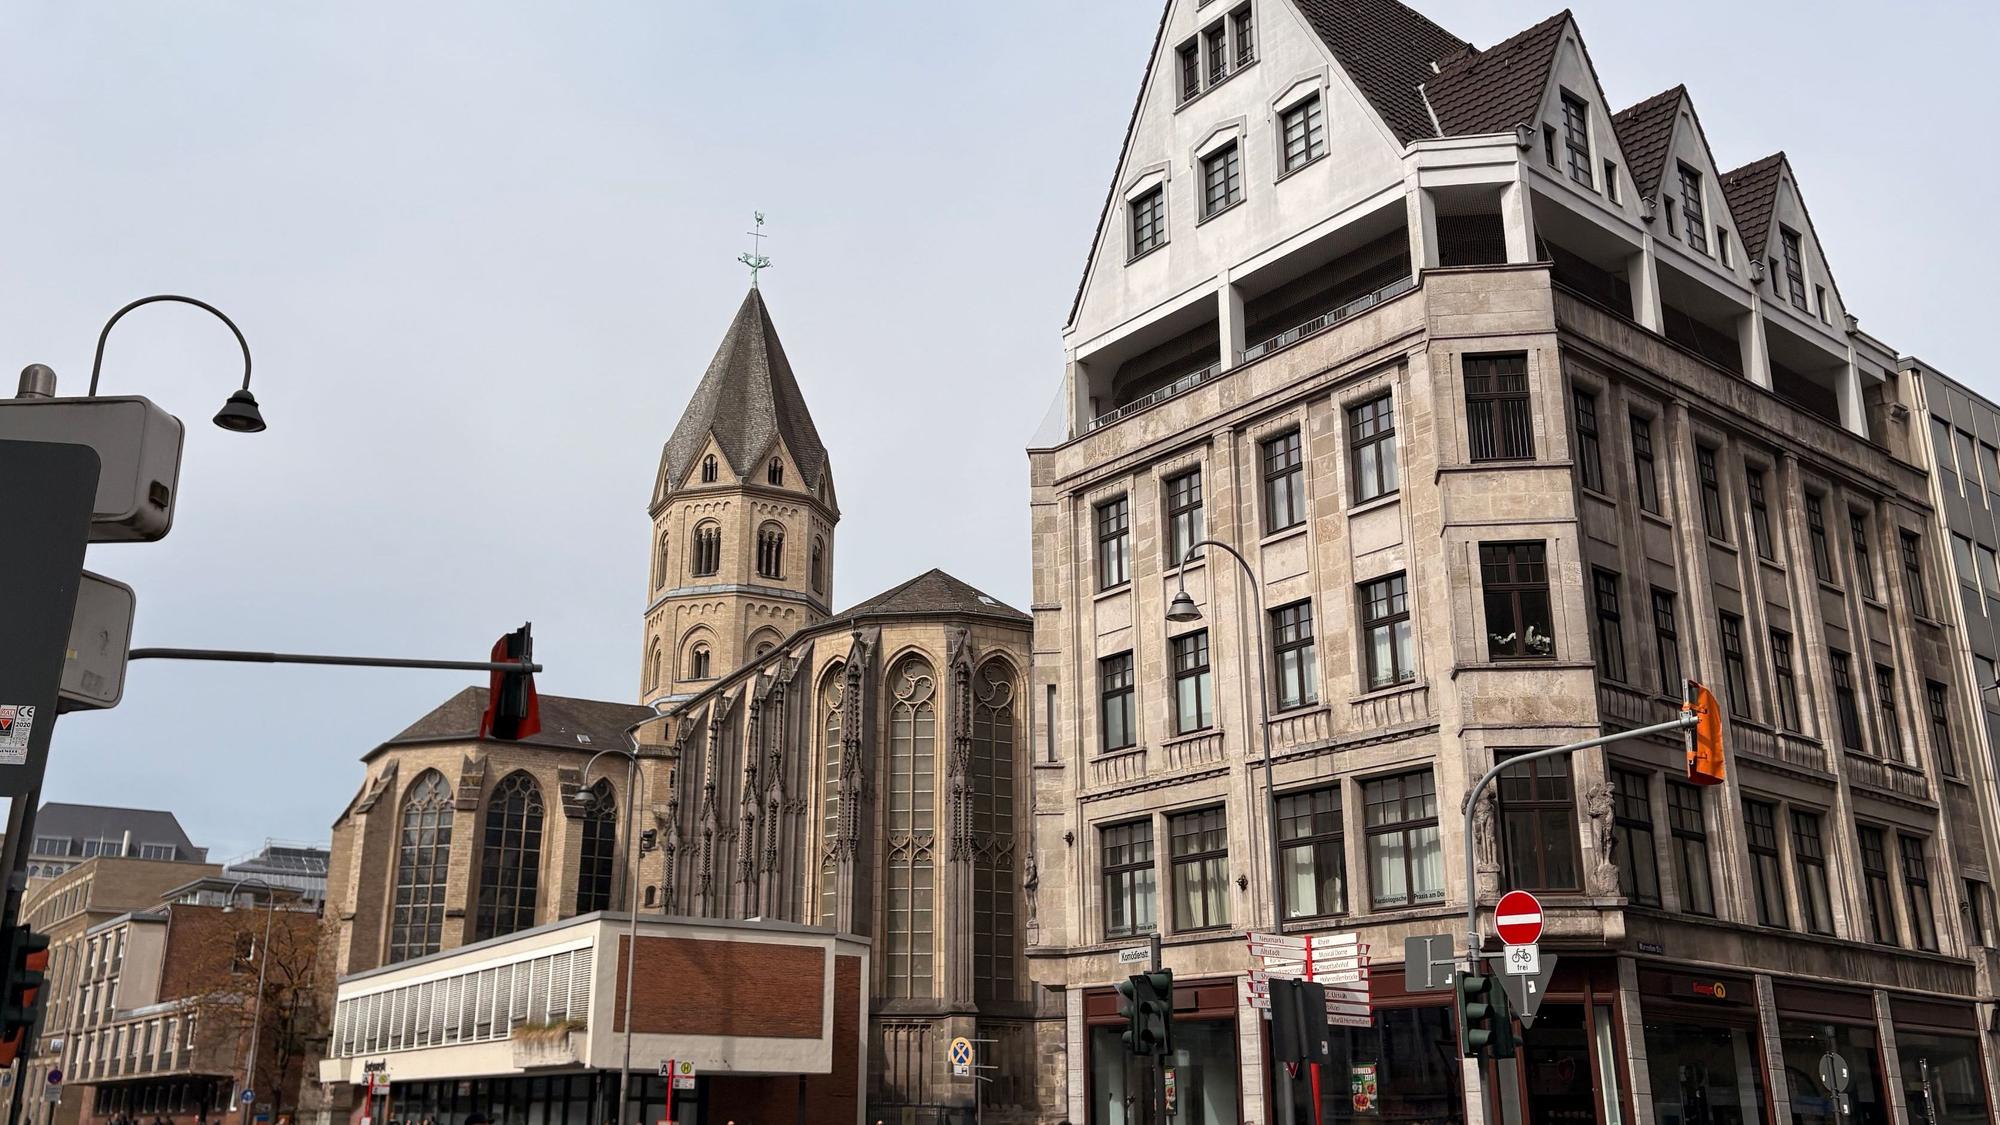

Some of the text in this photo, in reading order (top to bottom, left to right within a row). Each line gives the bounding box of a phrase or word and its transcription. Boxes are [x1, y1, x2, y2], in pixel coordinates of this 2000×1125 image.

[19, 706, 34, 717] CE
[1258, 935, 1285, 944] Neumarkt
[1260, 947, 1280, 956] Altstadt
[1319, 961, 1349, 970] Hauptbahnhof
[1320, 973, 1358, 982] Hohenzollernbrücke
[661, 1064, 668, 1074] A
